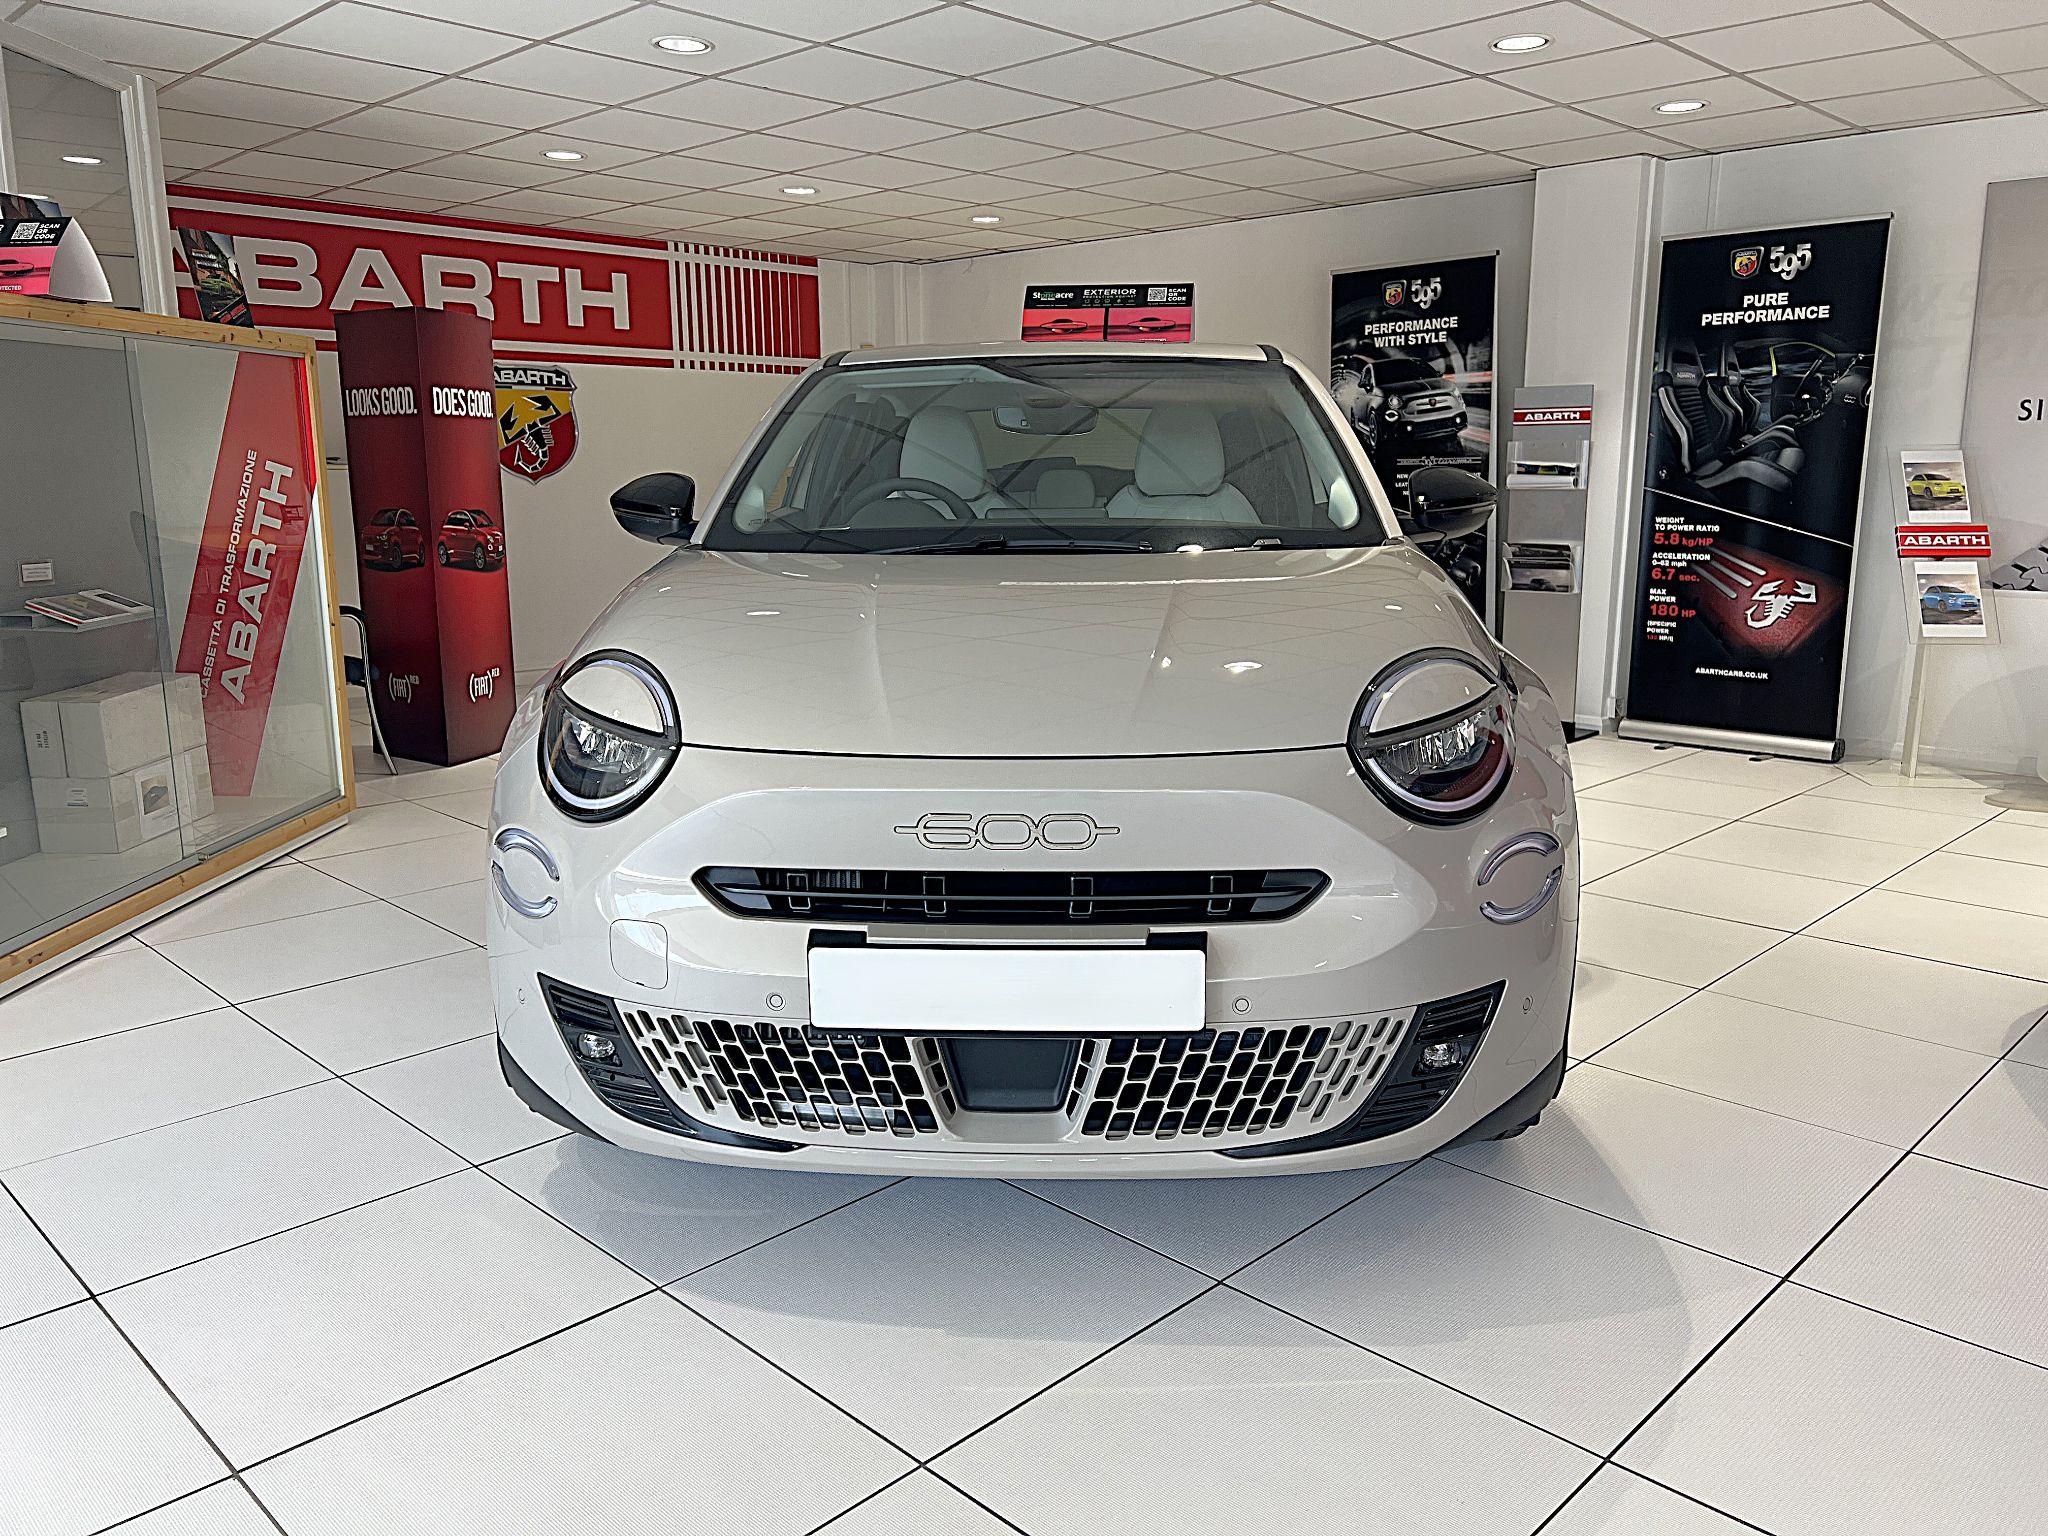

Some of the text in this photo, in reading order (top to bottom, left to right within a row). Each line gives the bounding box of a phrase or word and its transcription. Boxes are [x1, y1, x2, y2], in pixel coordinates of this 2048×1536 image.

[1770, 243, 1812, 280] 595
[170, 229, 630, 330] BARTH
[1411, 277, 1442, 309] 595
[1743, 292, 1789, 307] PURE
[1701, 305, 1830, 326] PERFORMANCE
[1364, 316, 1458, 335] PERFORMANCE
[1374, 332, 1447, 348] WITH STYLE
[345, 386, 418, 417] LOOKS GOOD.
[432, 386, 494, 418] DOES GOOD.
[1524, 412, 1580, 421] ABARTH
[1654, 532, 1713, 547] 5.8 kg/HP
[1904, 535, 1986, 546] ABARTH
[1652, 552, 1711, 560] ACCELERATION
[200, 449, 257, 699] CASSETTA DI TRASFORMAZIONE
[220, 460, 293, 705] ABARTH
[1651, 568, 1675, 581] 6.7
[1650, 604, 1696, 618] 180 HP
[1695, 667, 1768, 679] ABARTHCARS.CO.UK
[916, 812, 1098, 850] 600
